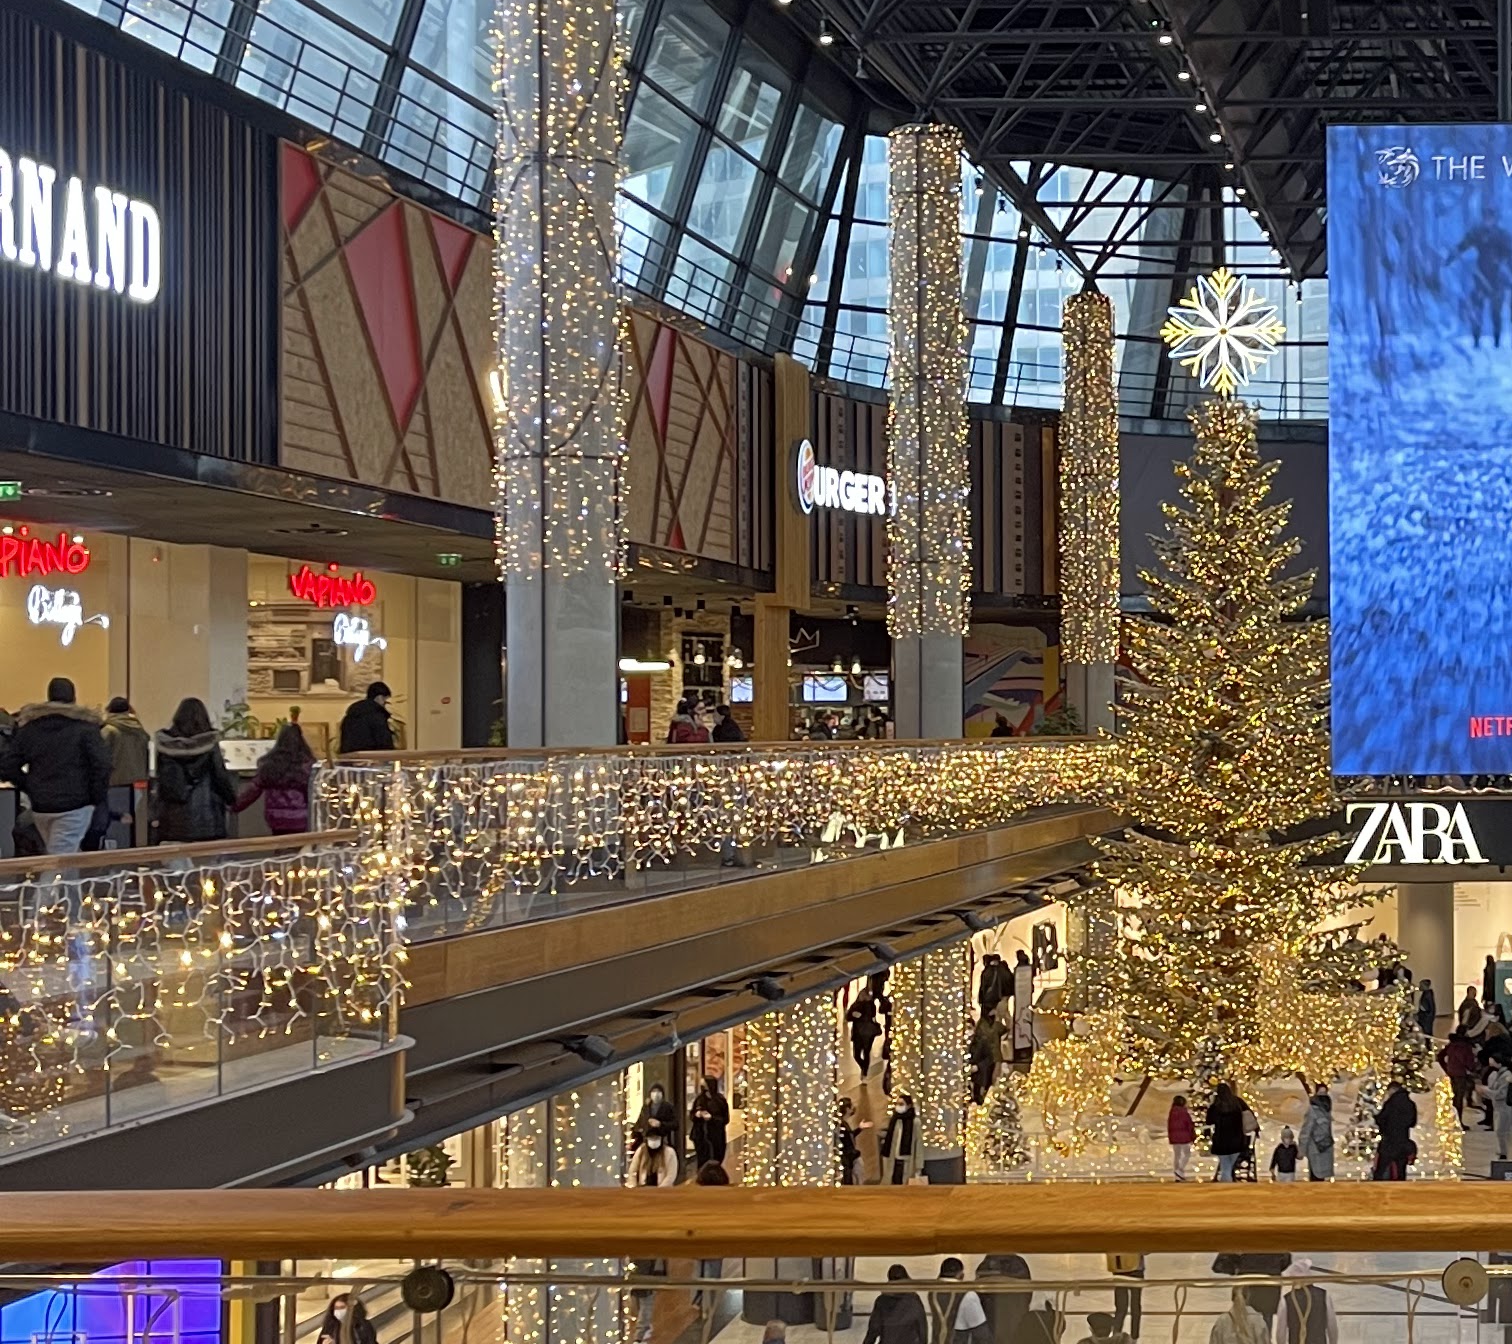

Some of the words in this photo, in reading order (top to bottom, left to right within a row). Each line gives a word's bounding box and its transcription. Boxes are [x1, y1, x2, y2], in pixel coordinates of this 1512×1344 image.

[1432, 155, 1486, 181] THE
[813, 464, 886, 516] URGER
[0, 525, 90, 577] PIANO
[1344, 801, 1490, 864] ZARA
